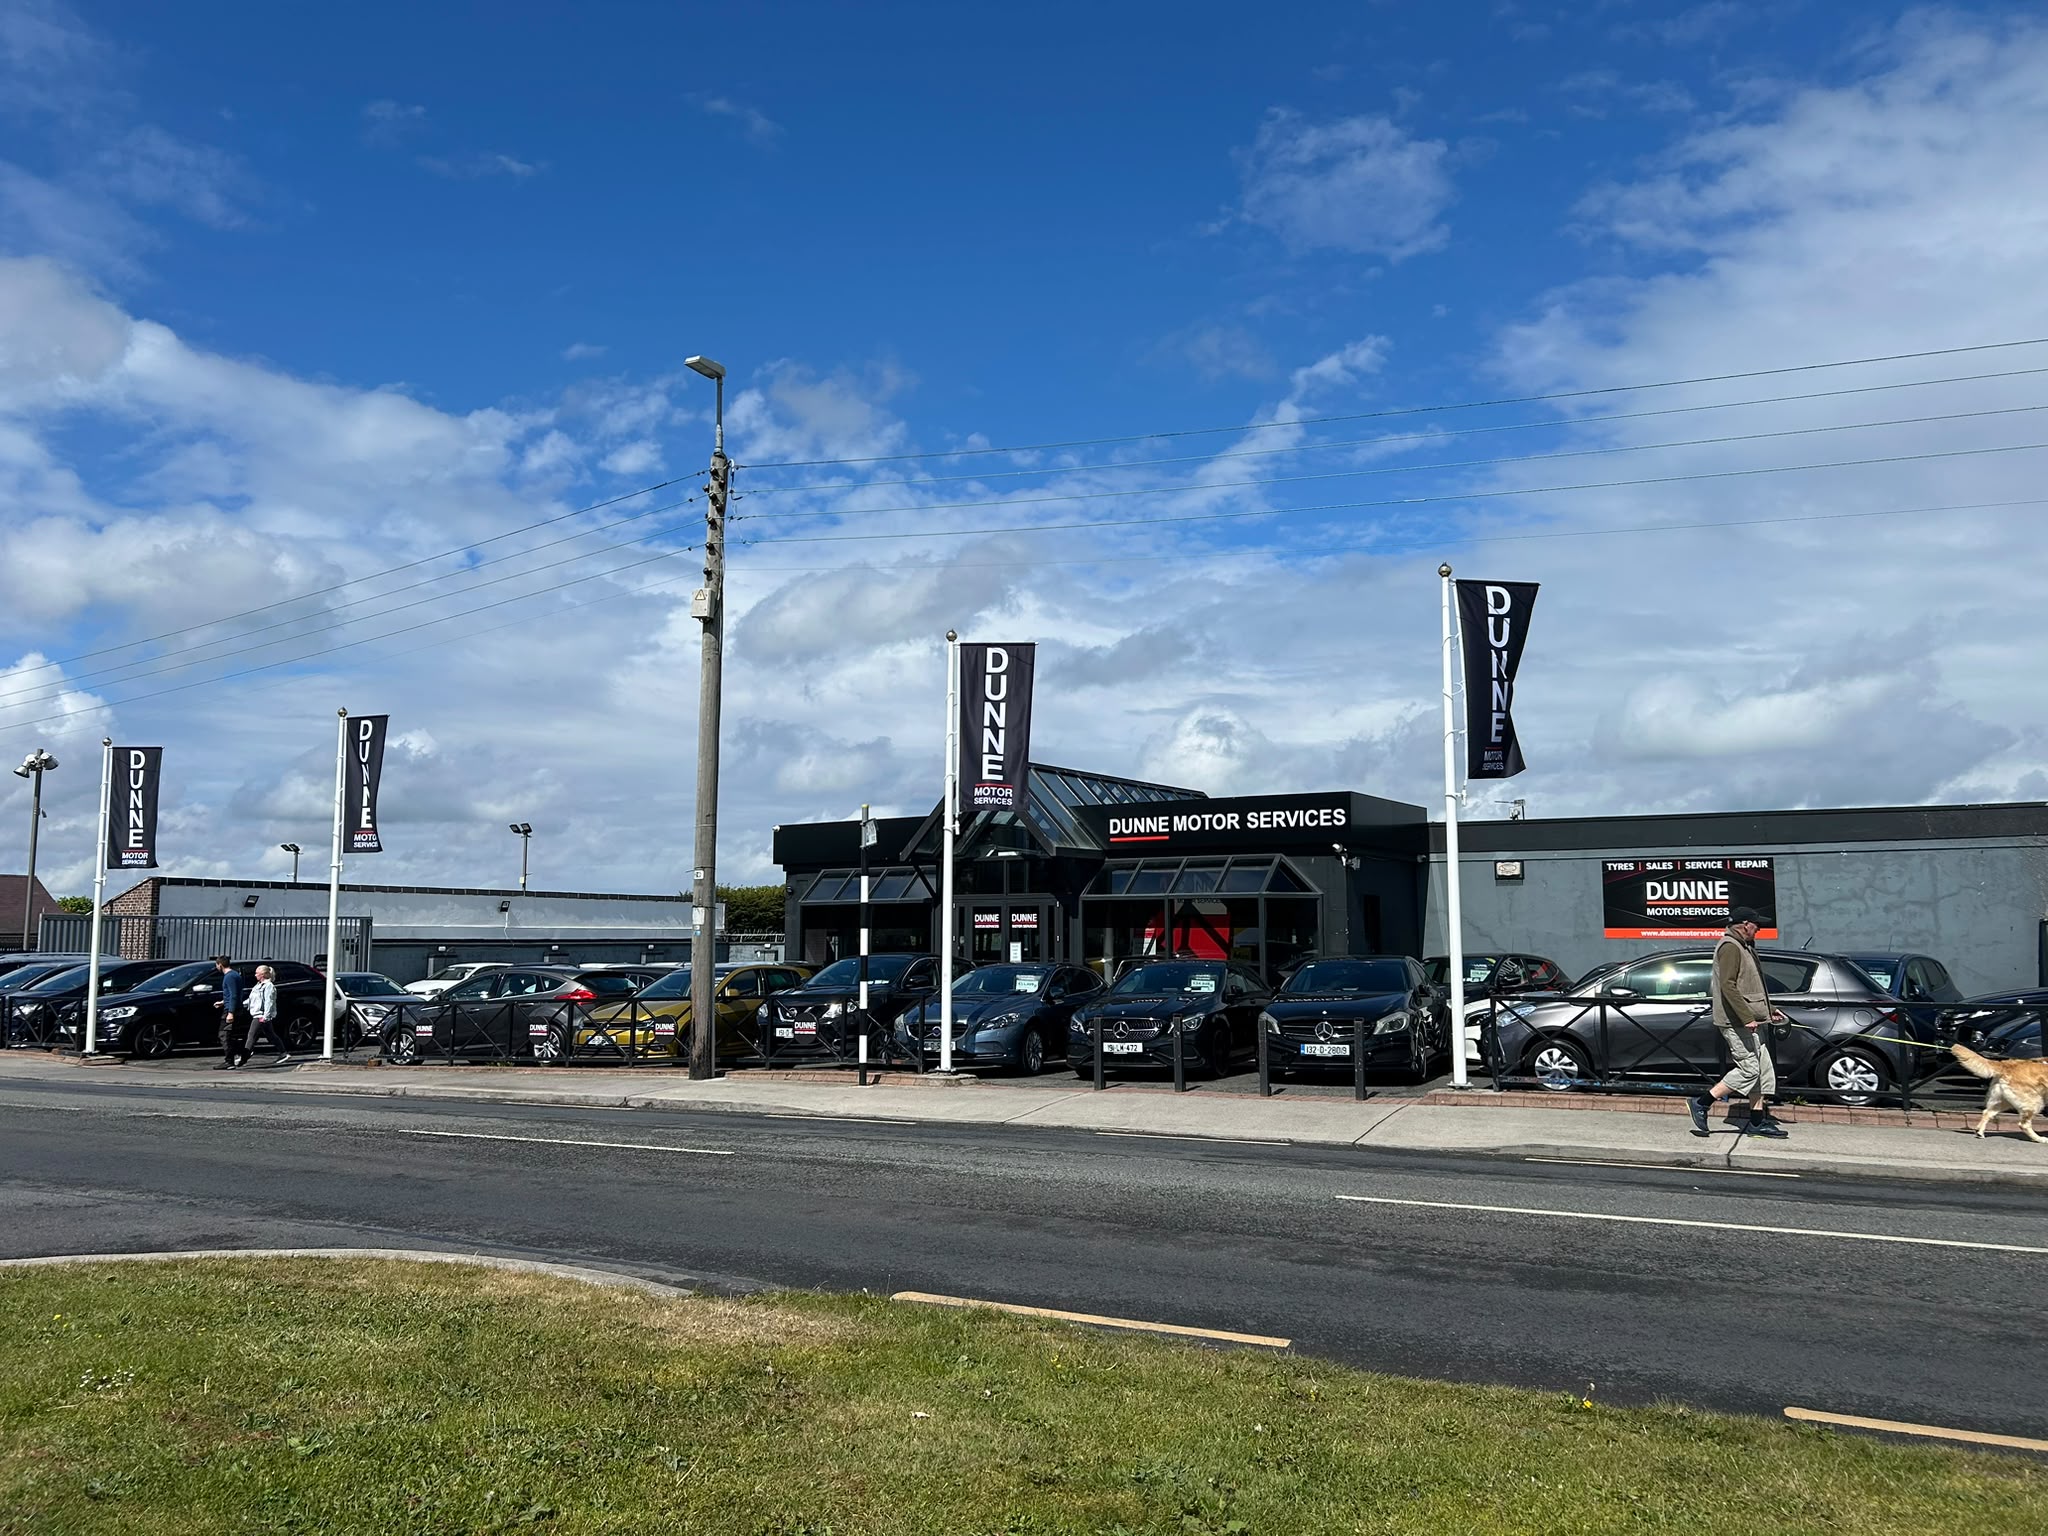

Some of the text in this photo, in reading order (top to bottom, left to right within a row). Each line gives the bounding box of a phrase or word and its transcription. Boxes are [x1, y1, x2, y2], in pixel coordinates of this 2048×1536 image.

[1485, 586, 1511, 743] DUNNE
[982, 647, 1009, 781] DUNNE
[974, 787, 1013, 797] MOTOR
[128, 750, 146, 848] DUNNE
[973, 797, 1013, 805] SERVICES
[1109, 808, 1346, 835] DUNNE MOTOR SERVICES
[354, 833, 377, 841] MOTO
[1606, 860, 1768, 871] TYRES SALES SERVICE REPAIR
[1646, 881, 1729, 900] DUNNE
[1646, 907, 1730, 916] MOTOR SERVICES
[974, 914, 1000, 922] DUNNE
[1011, 913, 1038, 922] DUNNE
[794, 1021, 817, 1029] DUNNE
